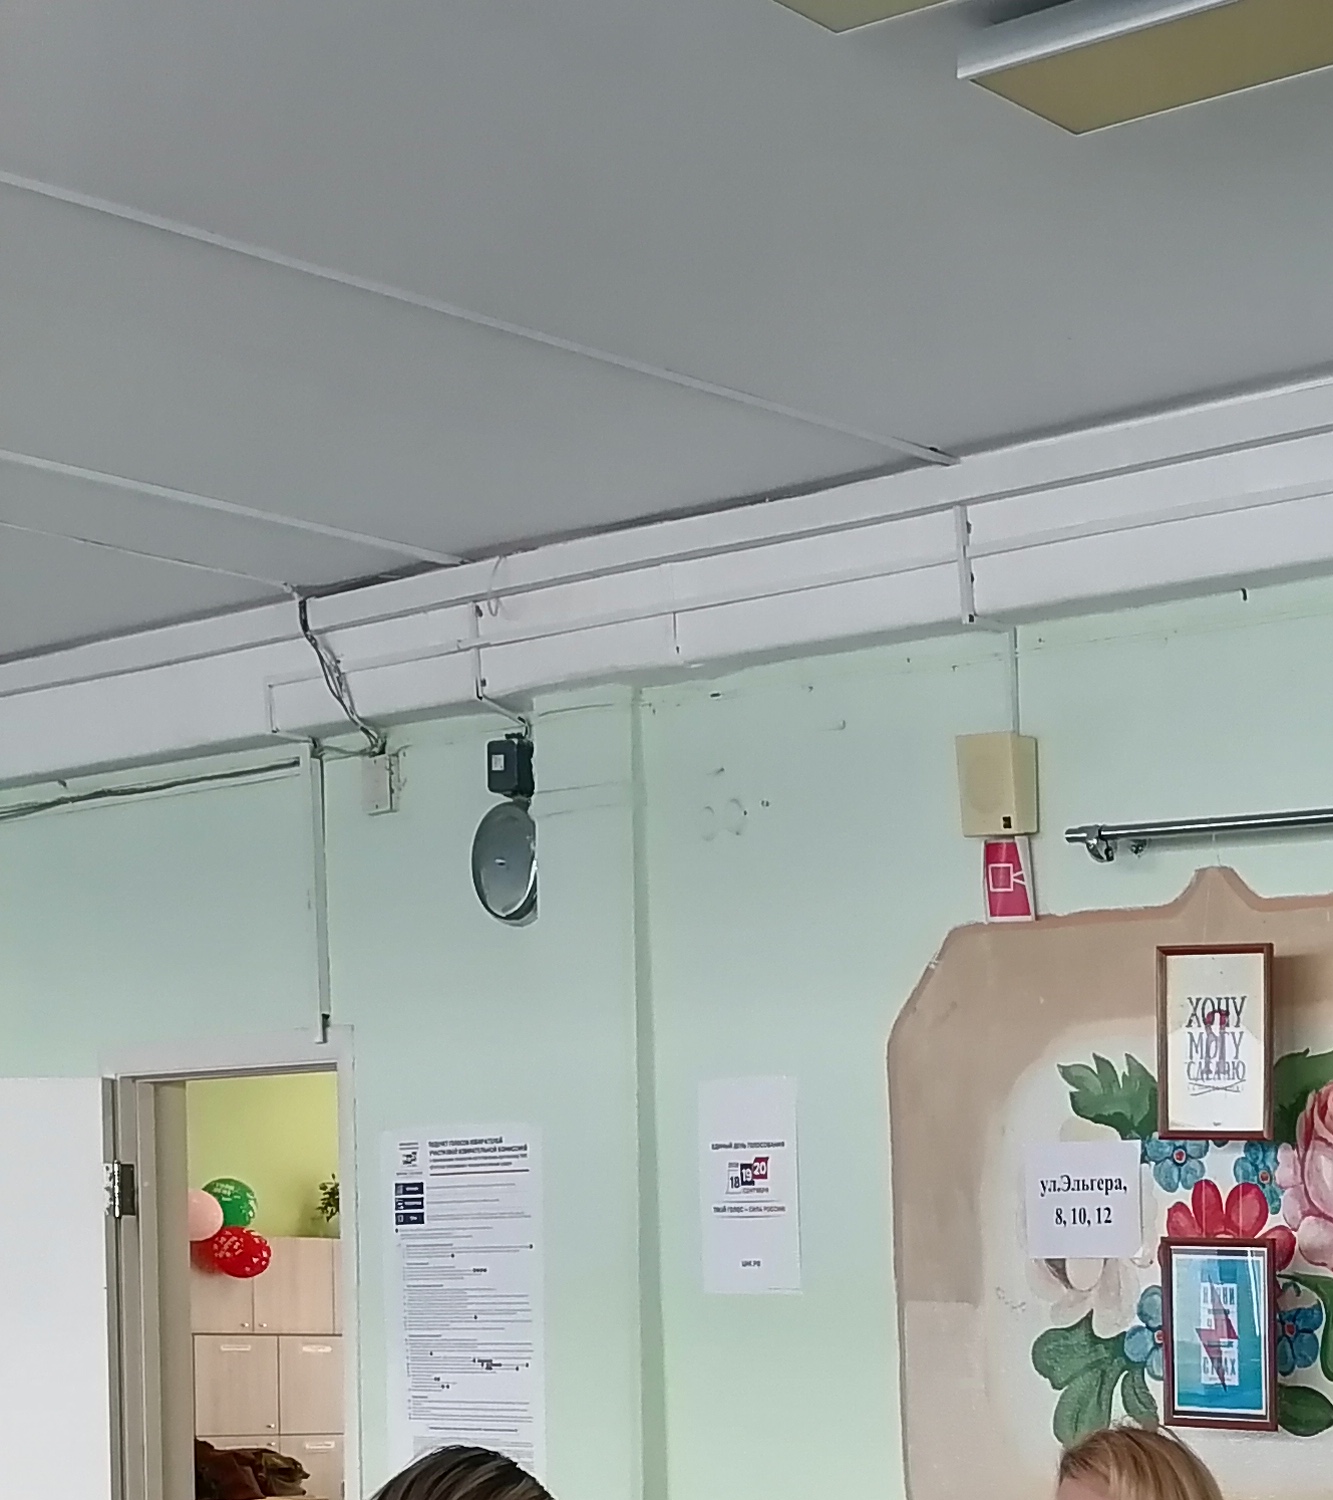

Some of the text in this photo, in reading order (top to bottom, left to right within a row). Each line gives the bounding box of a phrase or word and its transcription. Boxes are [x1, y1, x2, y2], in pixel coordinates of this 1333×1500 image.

[1187, 1031, 1244, 1060] МОГУ
[741, 1168, 752, 1181] 19
[752, 1162, 767, 1175] 20
[730, 1176, 740, 1189] 18
[1040, 1174, 1128, 1197] ул.Эльгера,
[1055, 1206, 1112, 1227] 8, 10, 12
